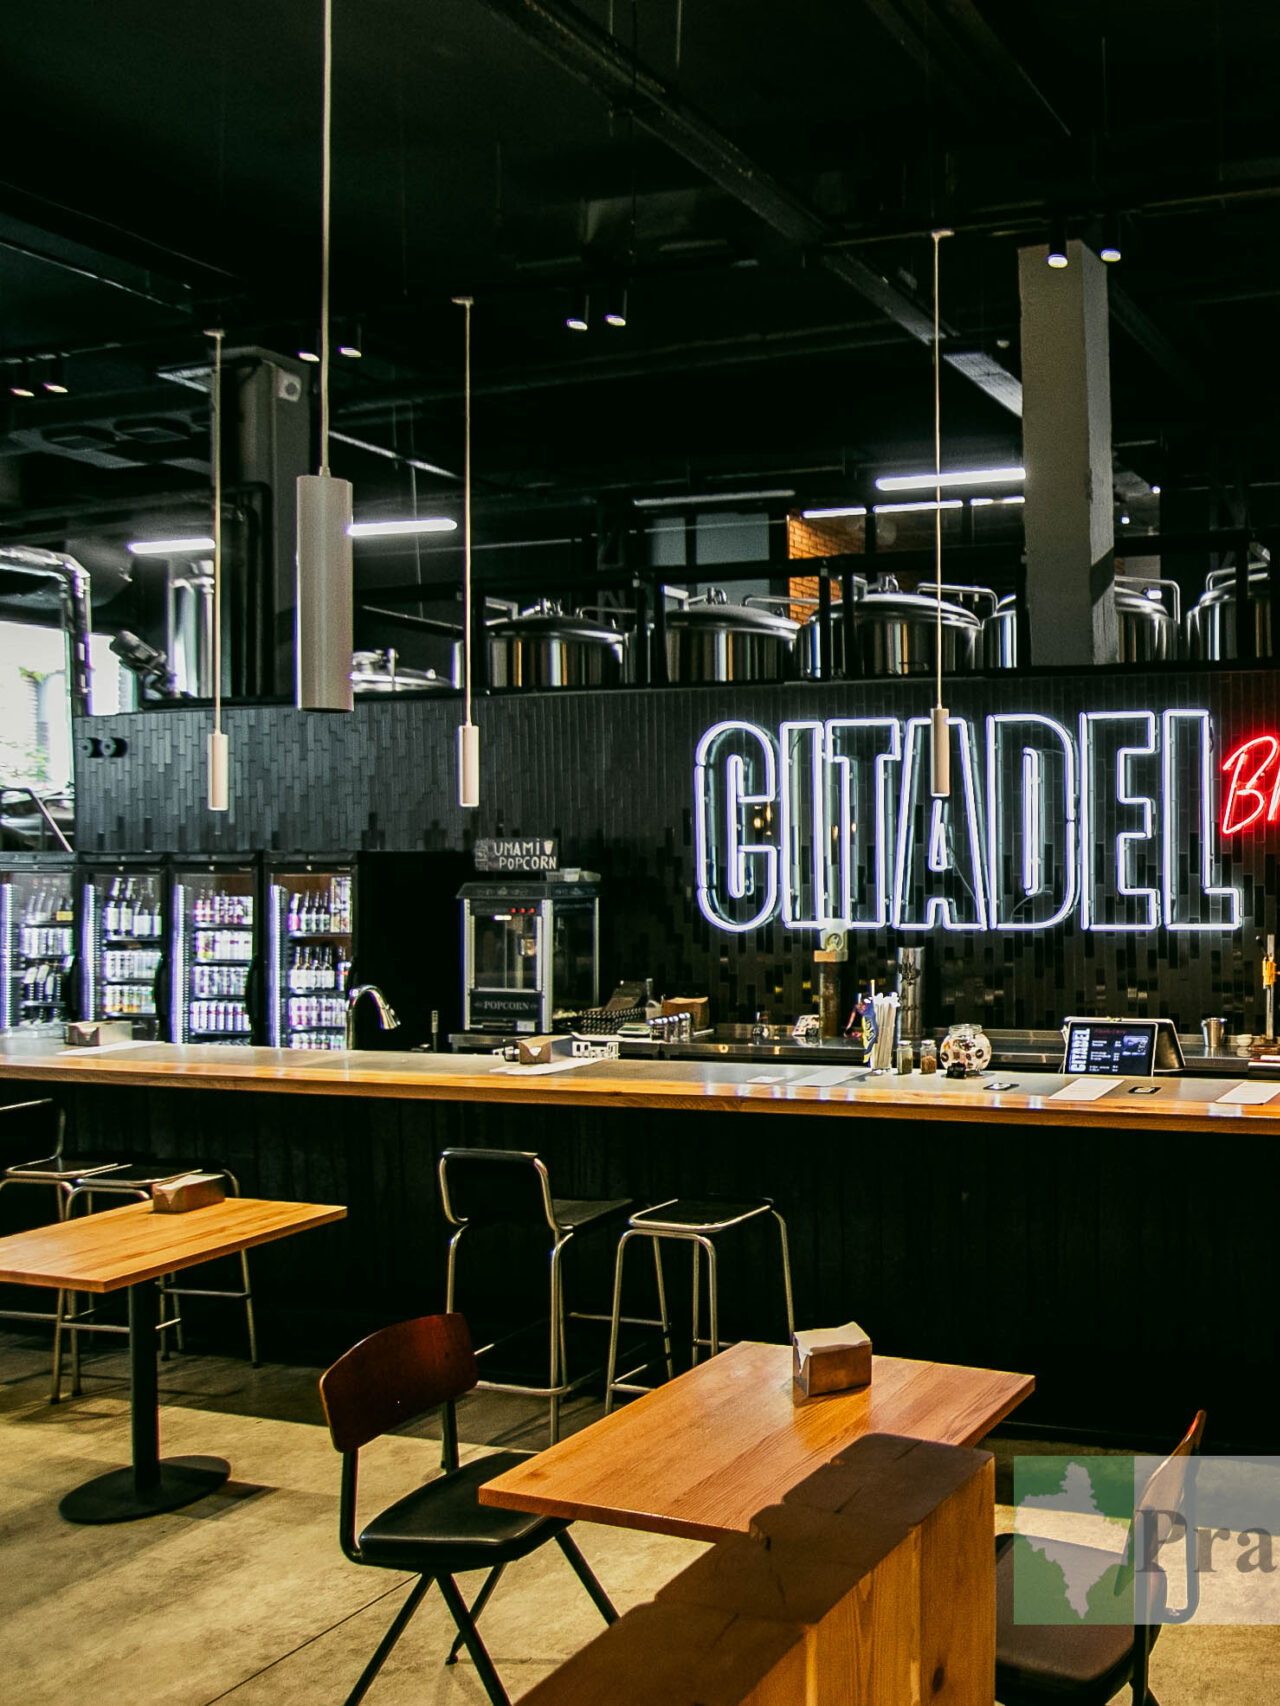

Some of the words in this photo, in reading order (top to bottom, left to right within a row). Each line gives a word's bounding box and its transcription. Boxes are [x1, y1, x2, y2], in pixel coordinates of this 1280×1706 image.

[695, 709, 1242, 932] CITADEL
[499, 855, 557, 871] POPCORN
[484, 1000, 530, 1010] POPCORN
